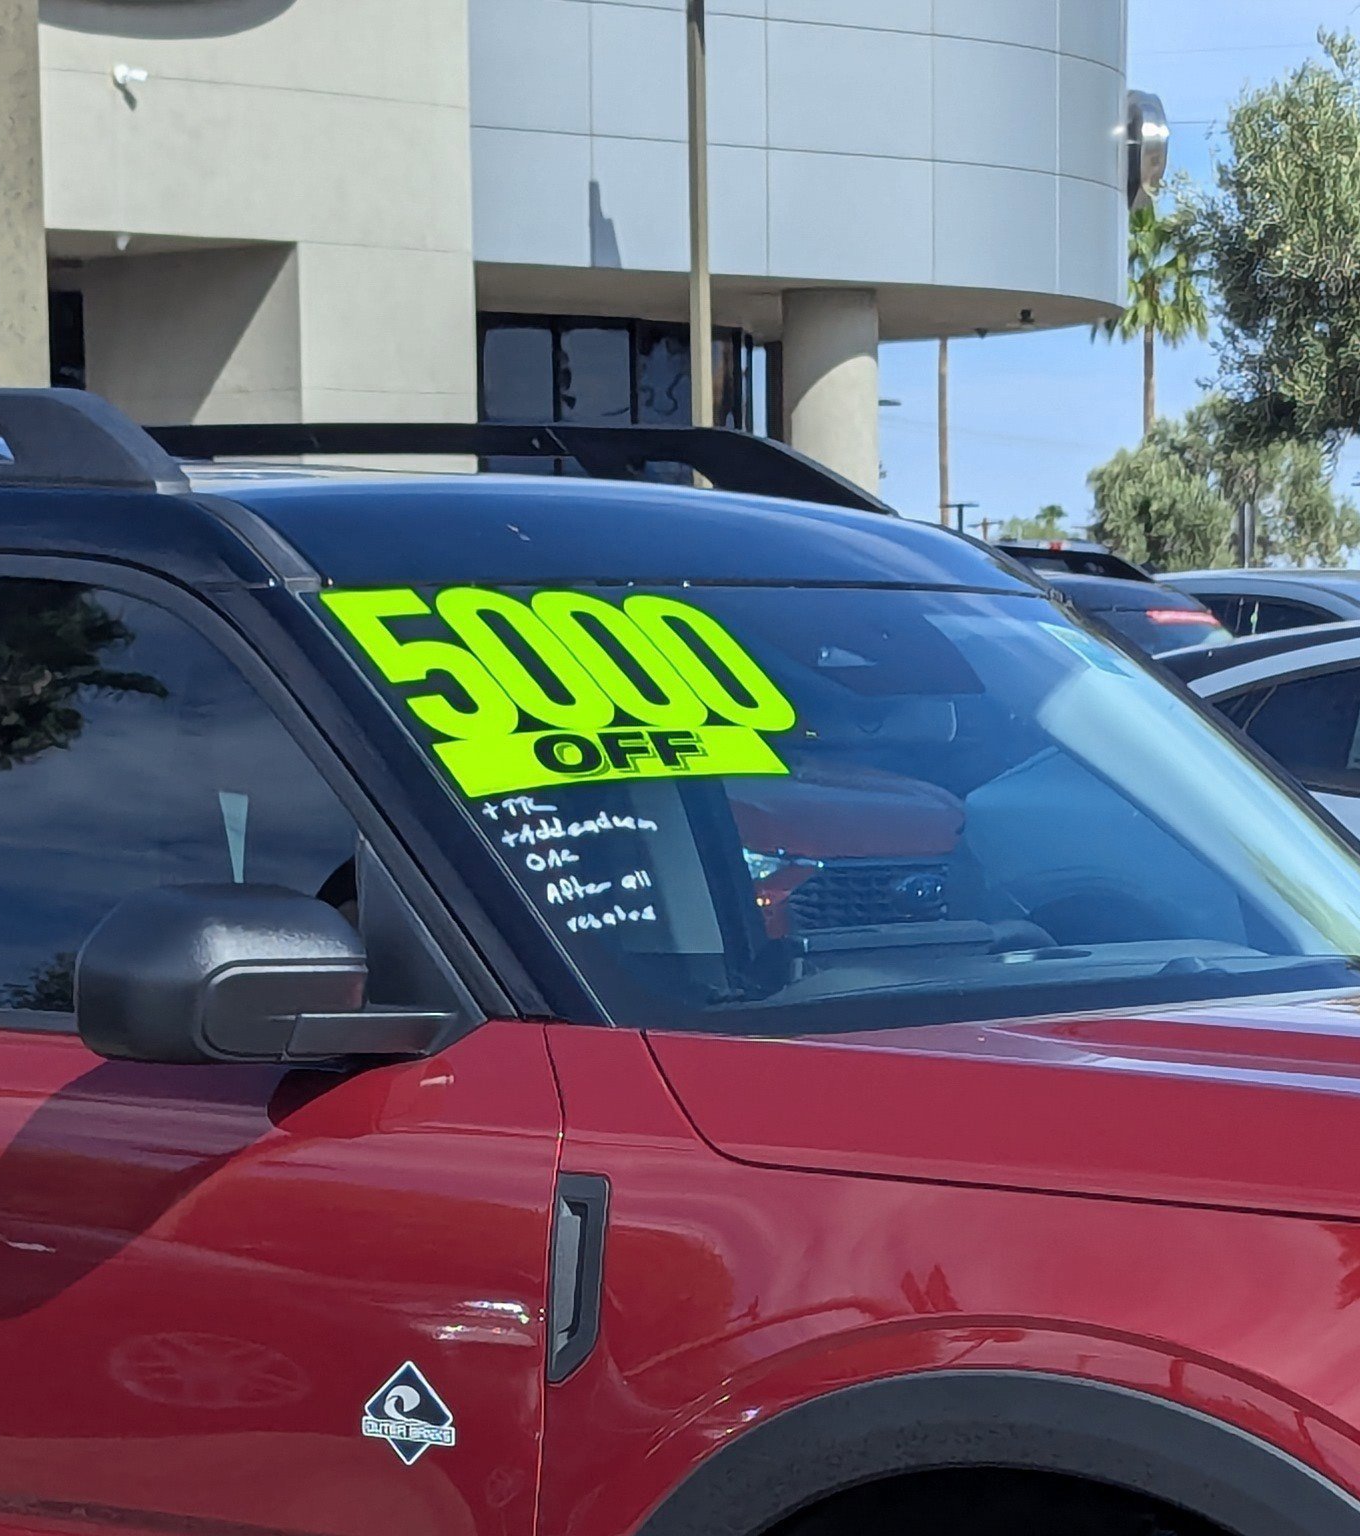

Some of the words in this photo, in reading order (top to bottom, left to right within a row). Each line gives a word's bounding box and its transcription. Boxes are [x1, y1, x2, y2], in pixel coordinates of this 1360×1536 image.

[321, 587, 795, 740] 5000
[533, 730, 706, 775] OFF
[621, 870, 652, 890] all
